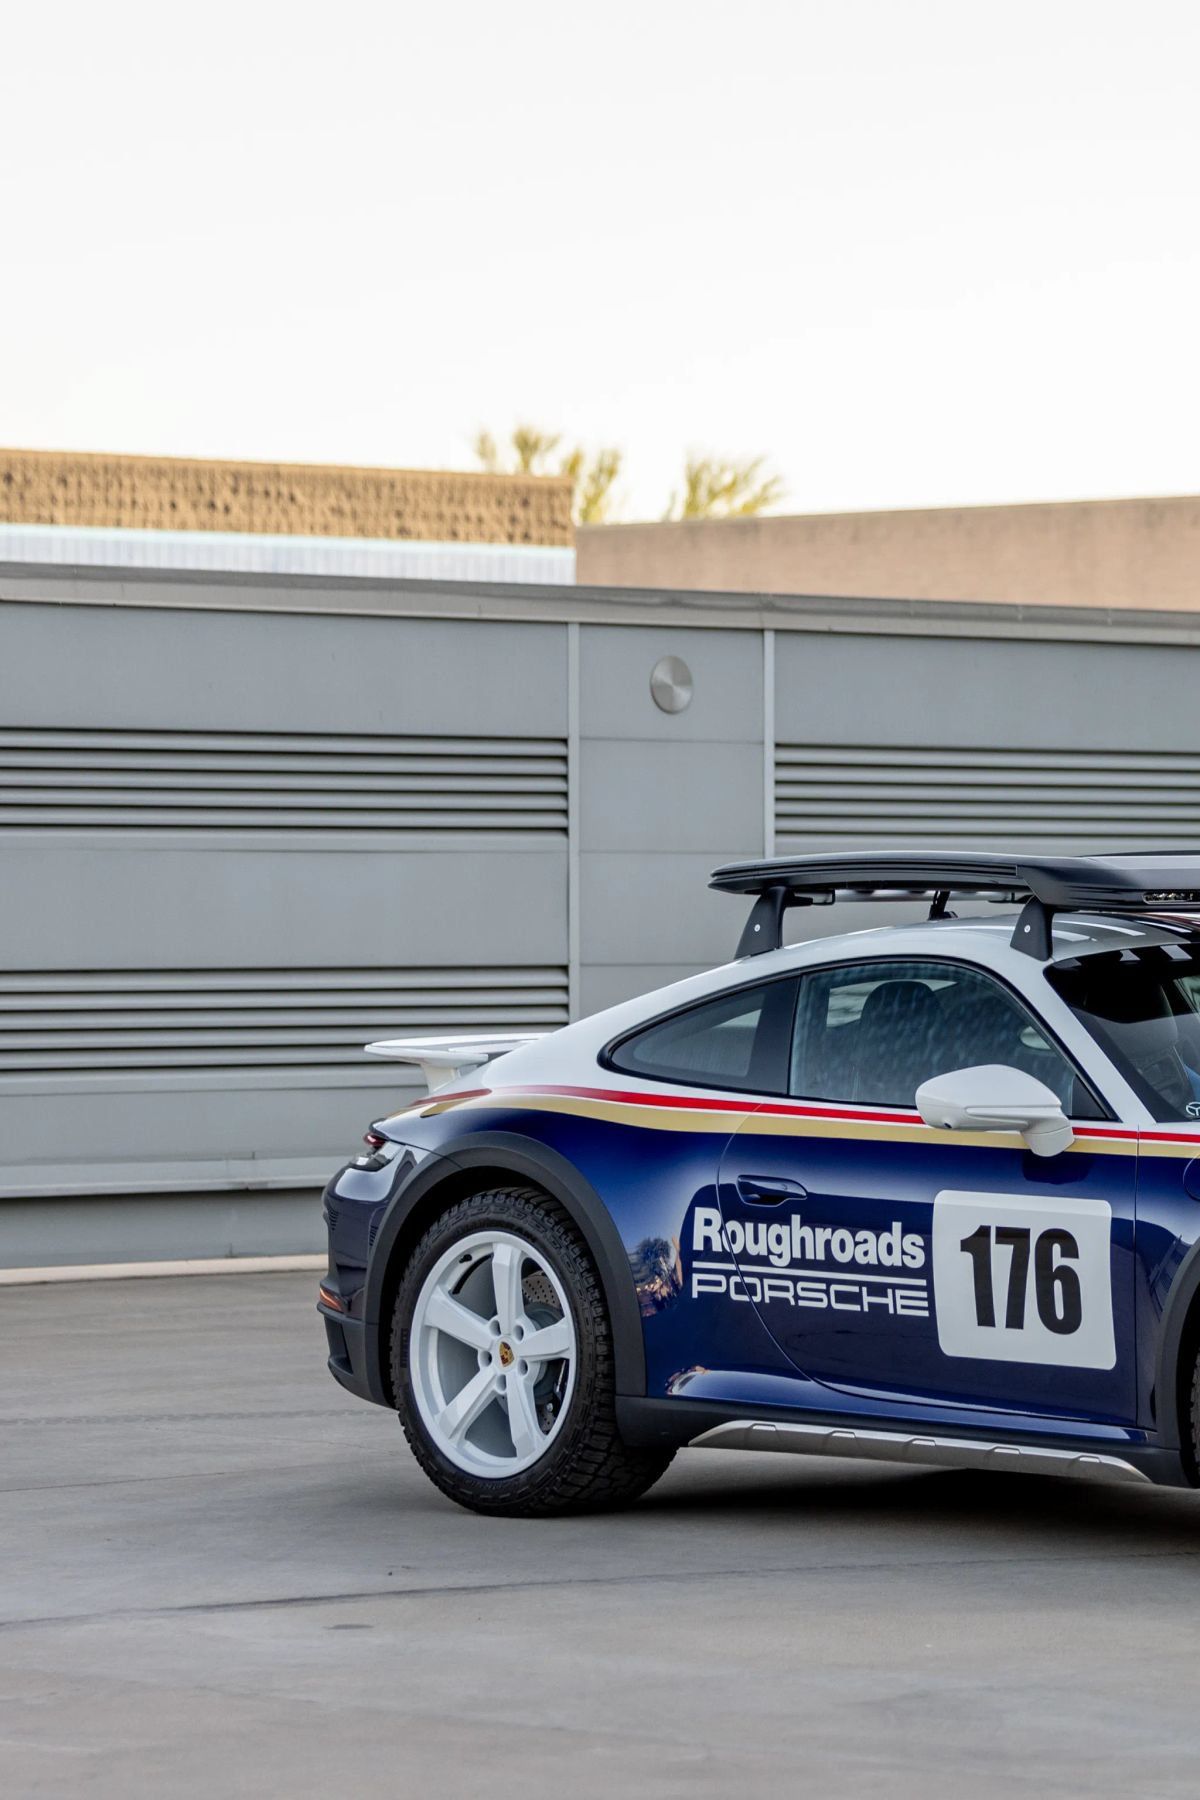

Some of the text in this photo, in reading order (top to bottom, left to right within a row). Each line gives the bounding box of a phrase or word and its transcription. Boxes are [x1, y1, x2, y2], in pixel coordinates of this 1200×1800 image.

[692, 1207, 926, 1269] Roughroads
[691, 1273, 930, 1317] PORSCHE
[960, 1224, 1083, 1336] 176
